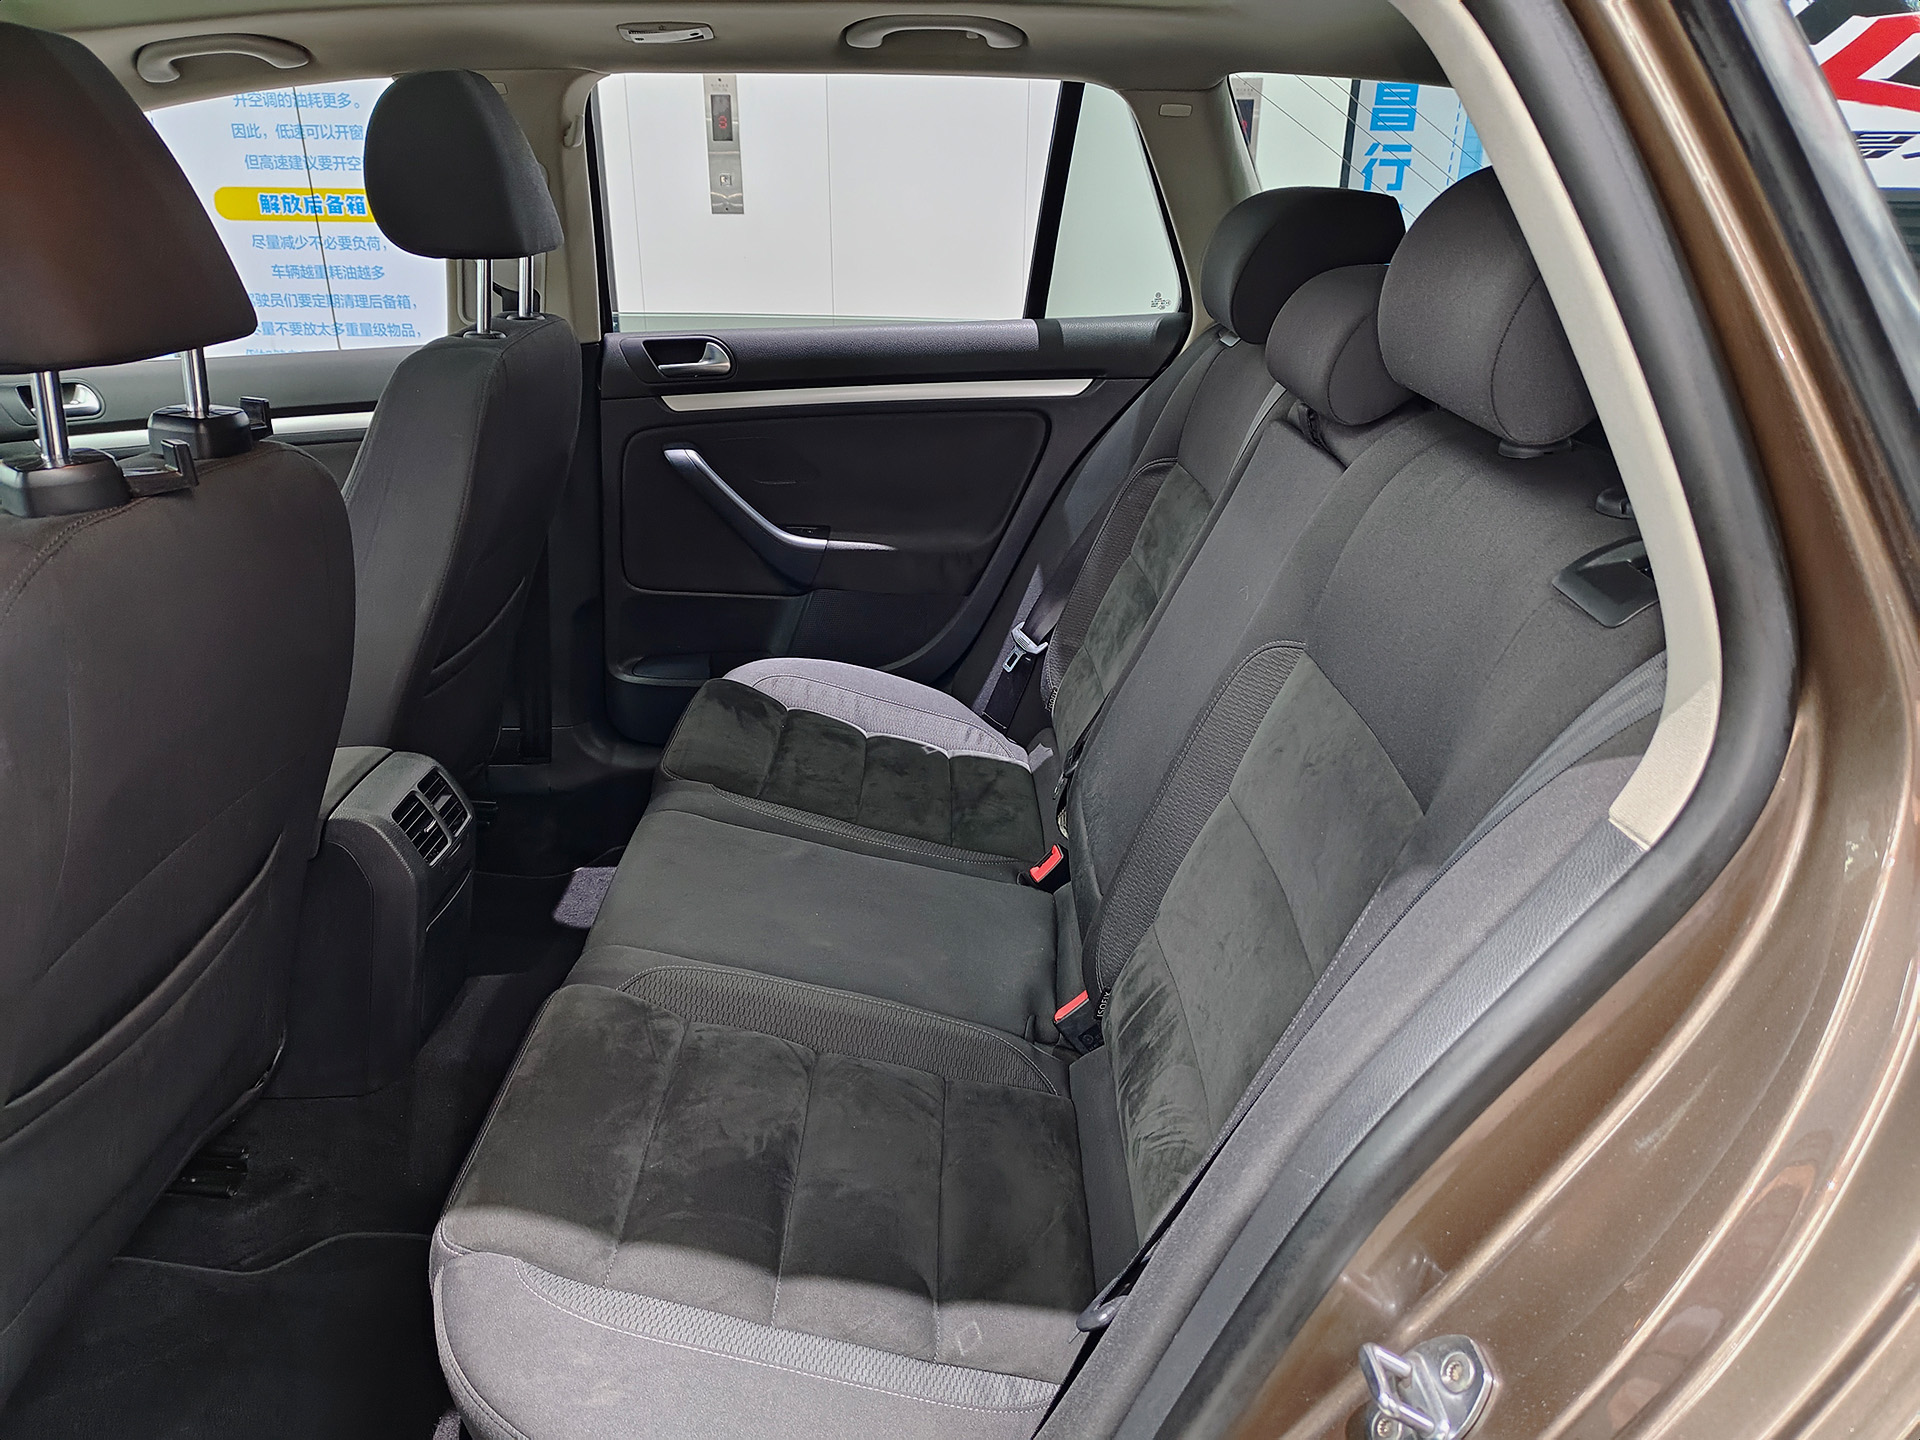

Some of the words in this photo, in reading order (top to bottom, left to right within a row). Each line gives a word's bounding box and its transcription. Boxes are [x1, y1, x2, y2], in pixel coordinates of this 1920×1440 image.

[258, 194, 367, 215] 解放后备箱
[271, 264, 385, 280] 车辆越重耗油越多
[254, 321, 422, 337] 量不要放太多重量级物品，
